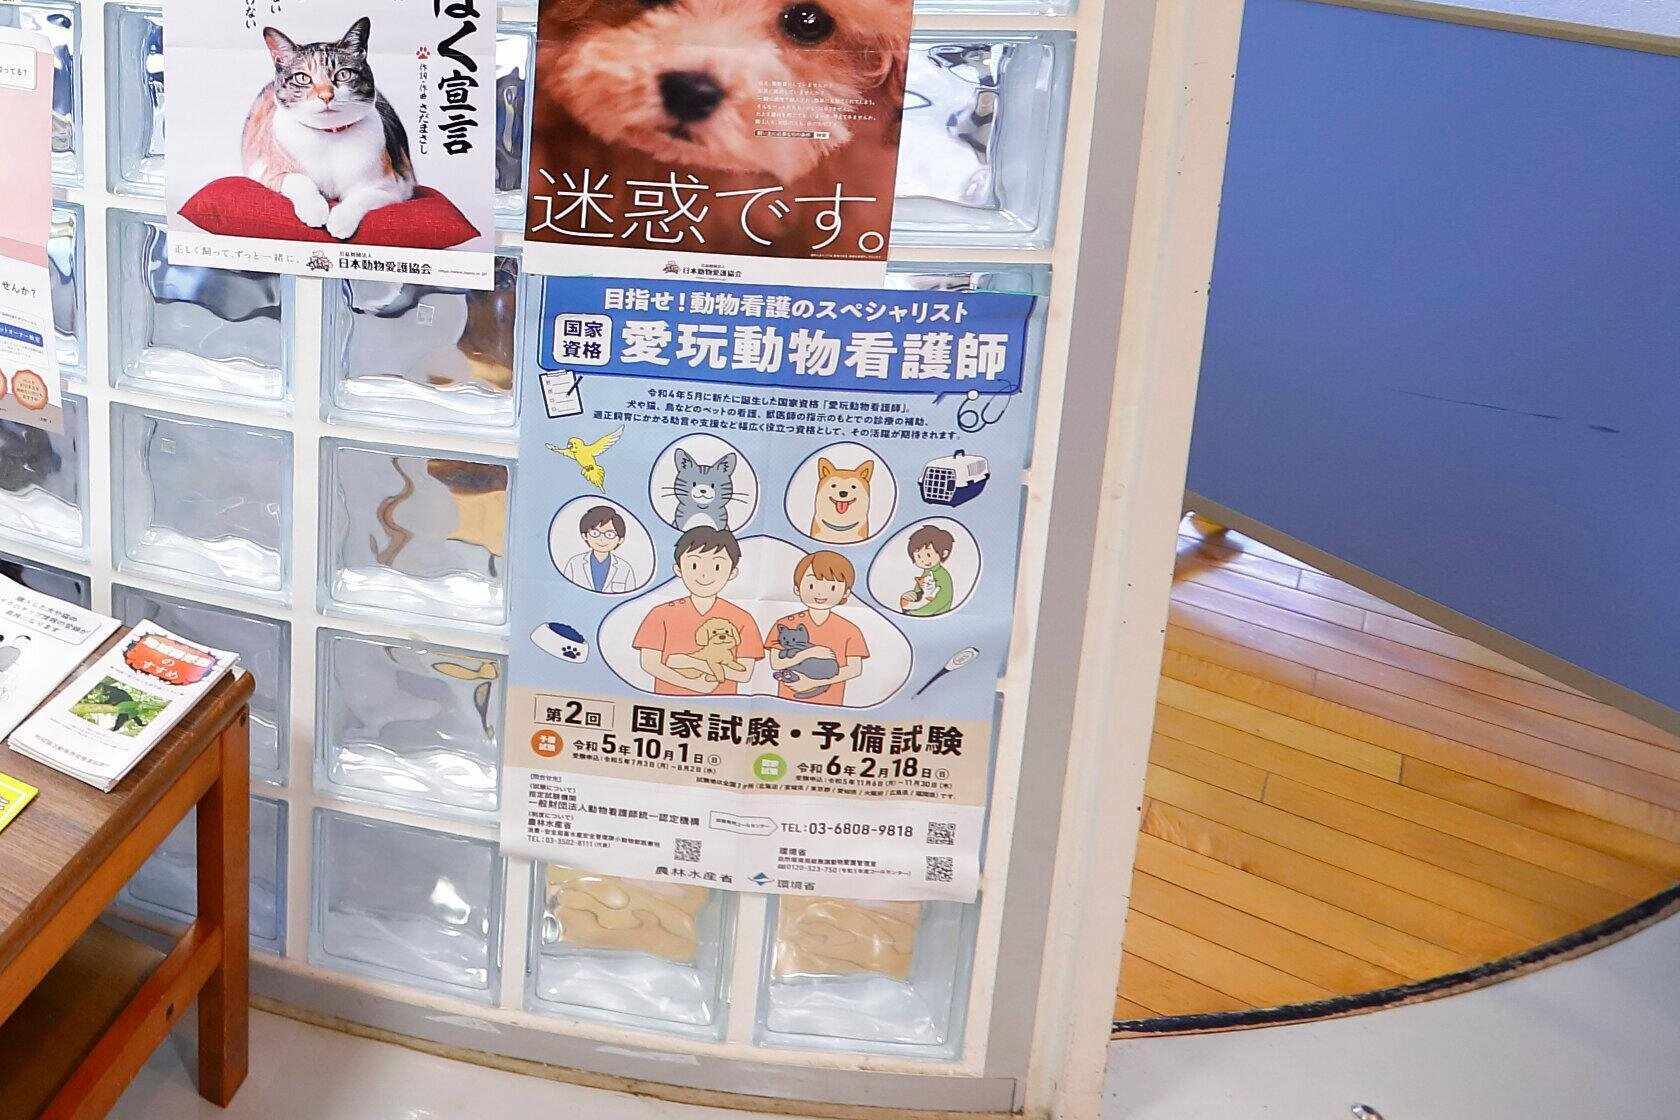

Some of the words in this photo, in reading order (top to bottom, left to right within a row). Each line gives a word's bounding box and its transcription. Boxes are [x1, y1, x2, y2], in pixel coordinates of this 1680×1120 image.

[531, 168, 884, 254] 迷惑です。
[604, 288, 969, 323] 目指せ！動物看護のスペシャリスト
[563, 319, 603, 338] 国家
[563, 340, 603, 360] 資格
[620, 320, 1009, 381] 愛玩動物看護師
[546, 701, 602, 727] 第2回
[631, 704, 963, 756] 国家試験・予備試験
